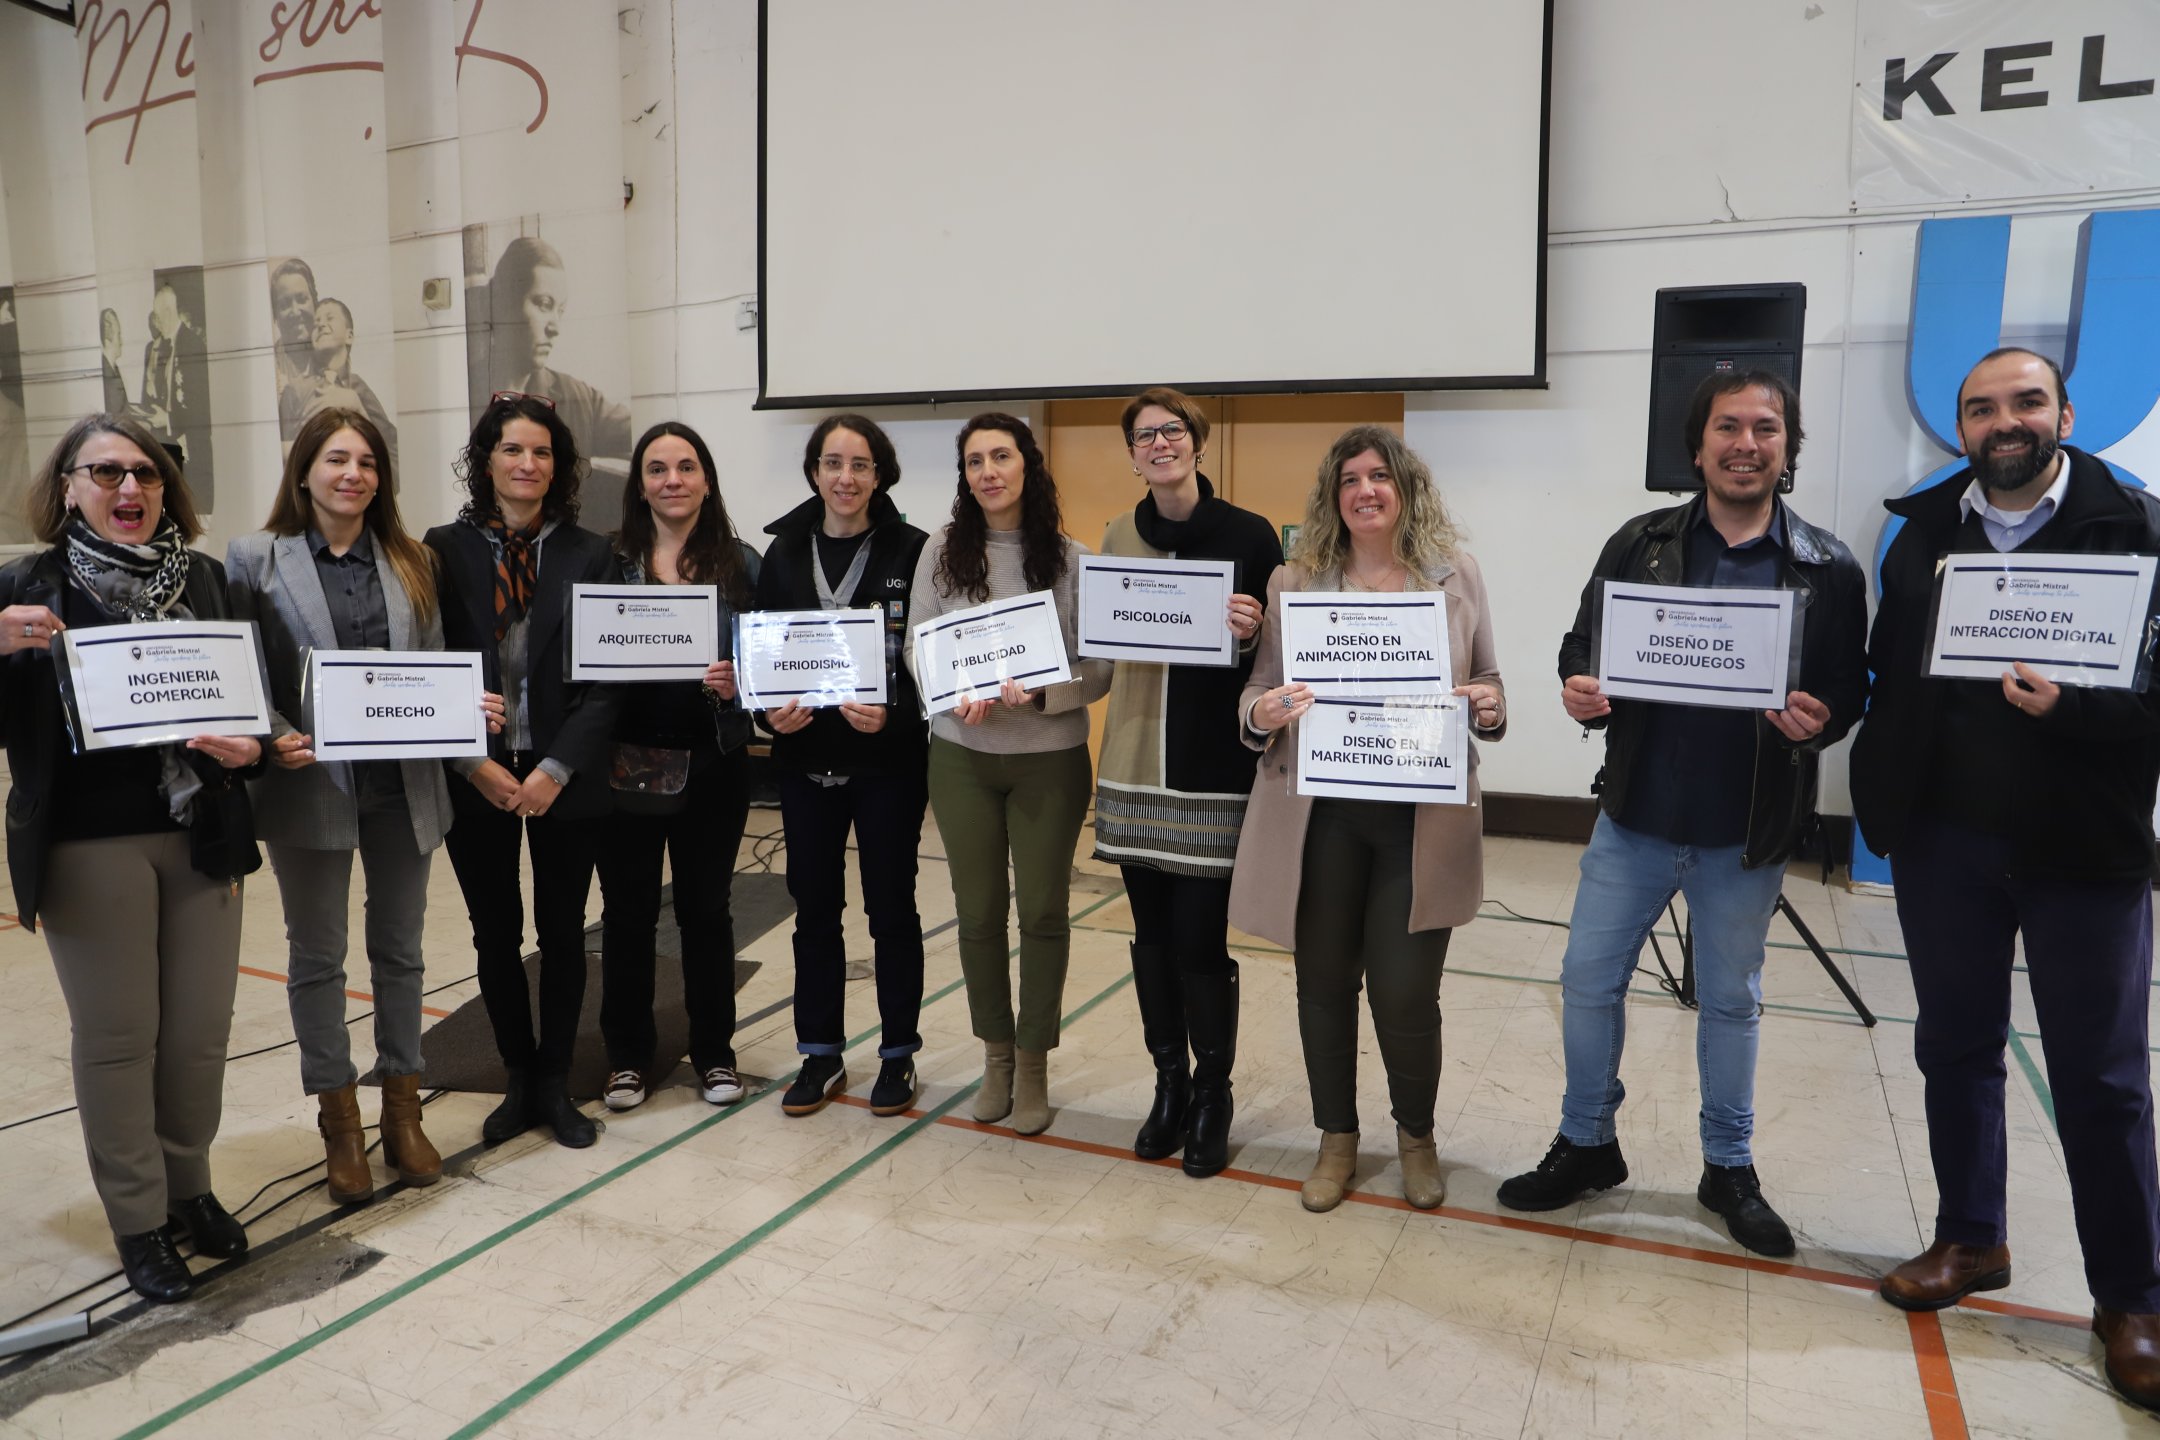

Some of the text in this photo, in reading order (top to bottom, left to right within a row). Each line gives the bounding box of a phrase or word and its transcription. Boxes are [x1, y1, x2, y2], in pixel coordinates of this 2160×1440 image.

[1883, 34, 2155, 121] KEL
[1113, 610, 1192, 625] PSICOLOGÍA
[1989, 607, 2073, 624] DISEÑO EN
[598, 634, 692, 646] ARQUITECTURA
[1326, 633, 1401, 646] DISEÑO EN
[1649, 634, 1734, 651] DISEÑO DE
[1950, 625, 2116, 645] INTERACCION DIGITAL
[952, 644, 1026, 670] PUBLICIDAD
[1296, 650, 1434, 662] ANIMACION DIGITAL
[1636, 651, 1745, 670] VIDEOJUEGOS
[128, 669, 220, 686] INGENIERIA
[130, 687, 225, 705] COMERCIAL
[366, 706, 435, 718] DERECHO
[1343, 734, 1420, 750] DISEÑO EN
[1311, 750, 1452, 768] MARKETING DIGITAL
